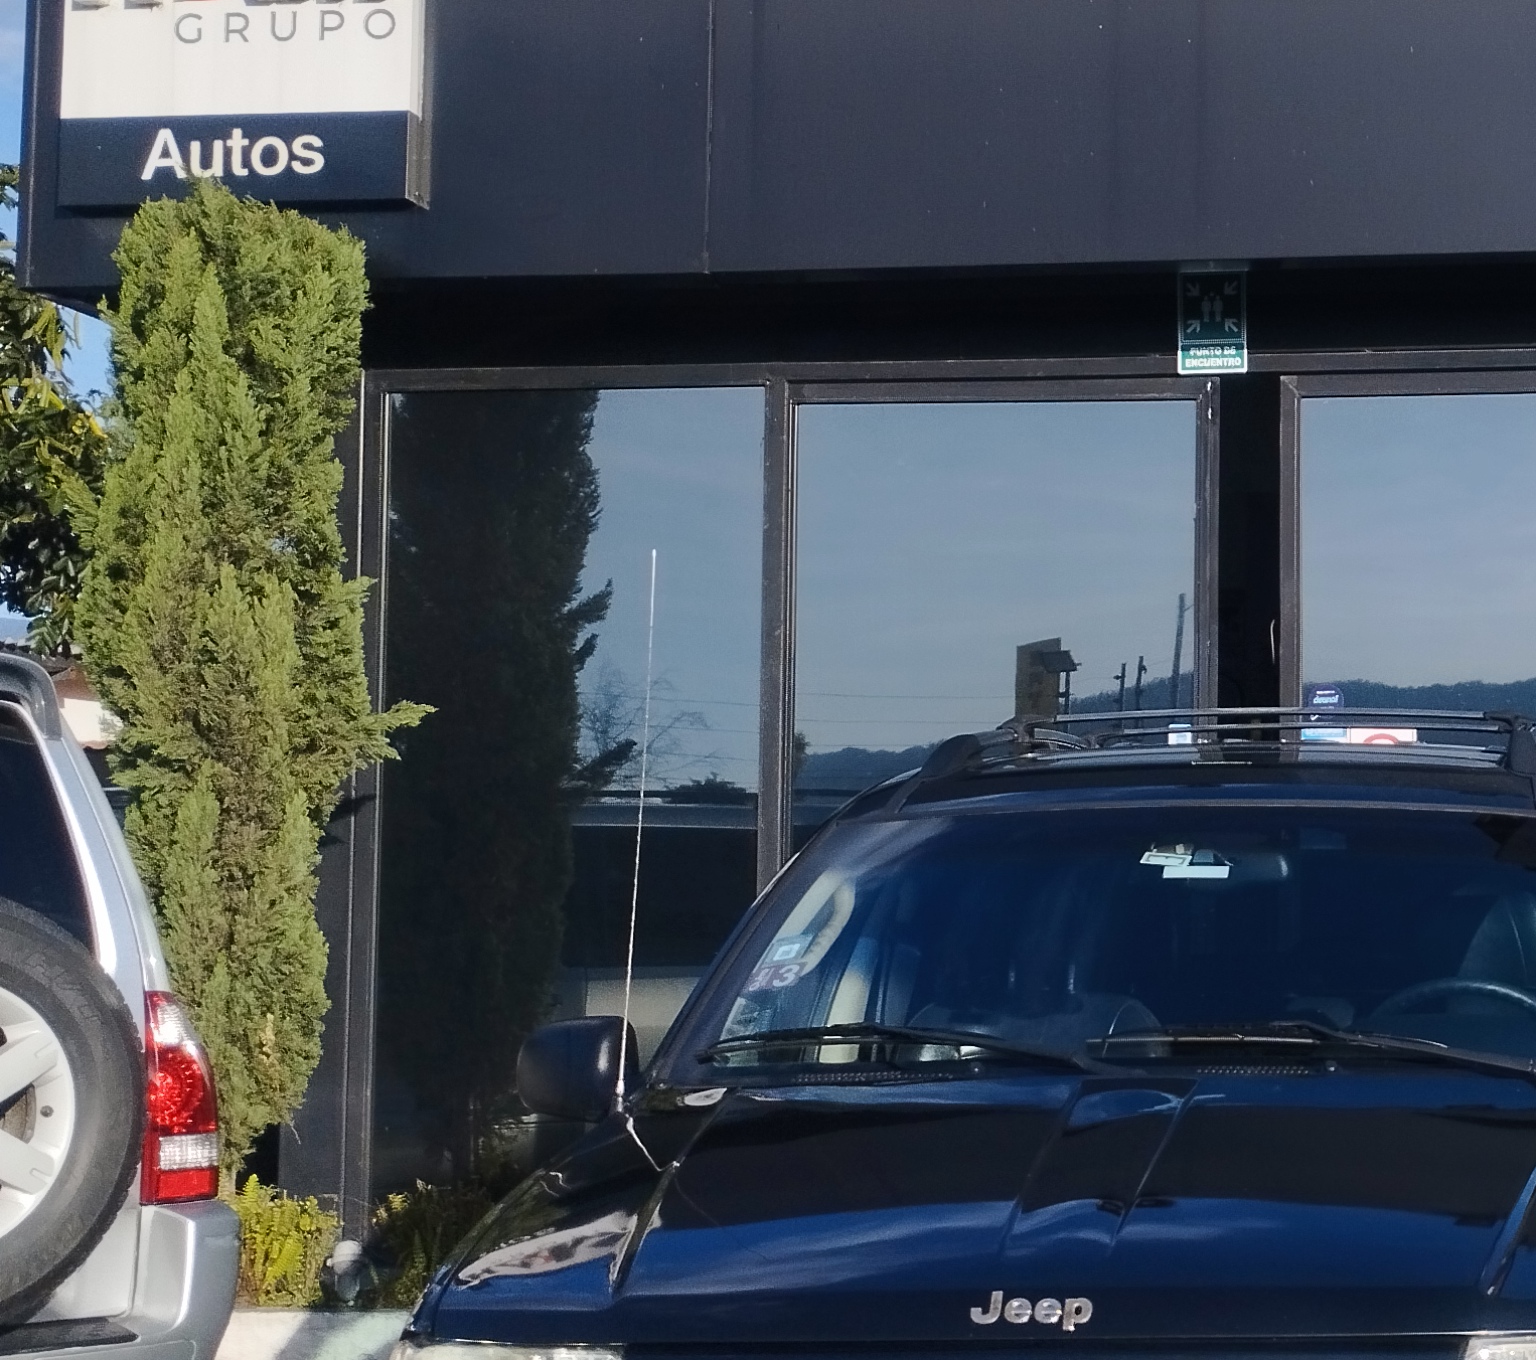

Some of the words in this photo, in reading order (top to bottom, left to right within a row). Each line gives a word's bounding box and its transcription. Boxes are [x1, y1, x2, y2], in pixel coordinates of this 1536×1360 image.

[174, 8, 397, 44] GRUPO
[141, 128, 325, 180] Autos
[1185, 356, 1242, 368] ENCUENTRO
[970, 1290, 1093, 1332] Jeep
